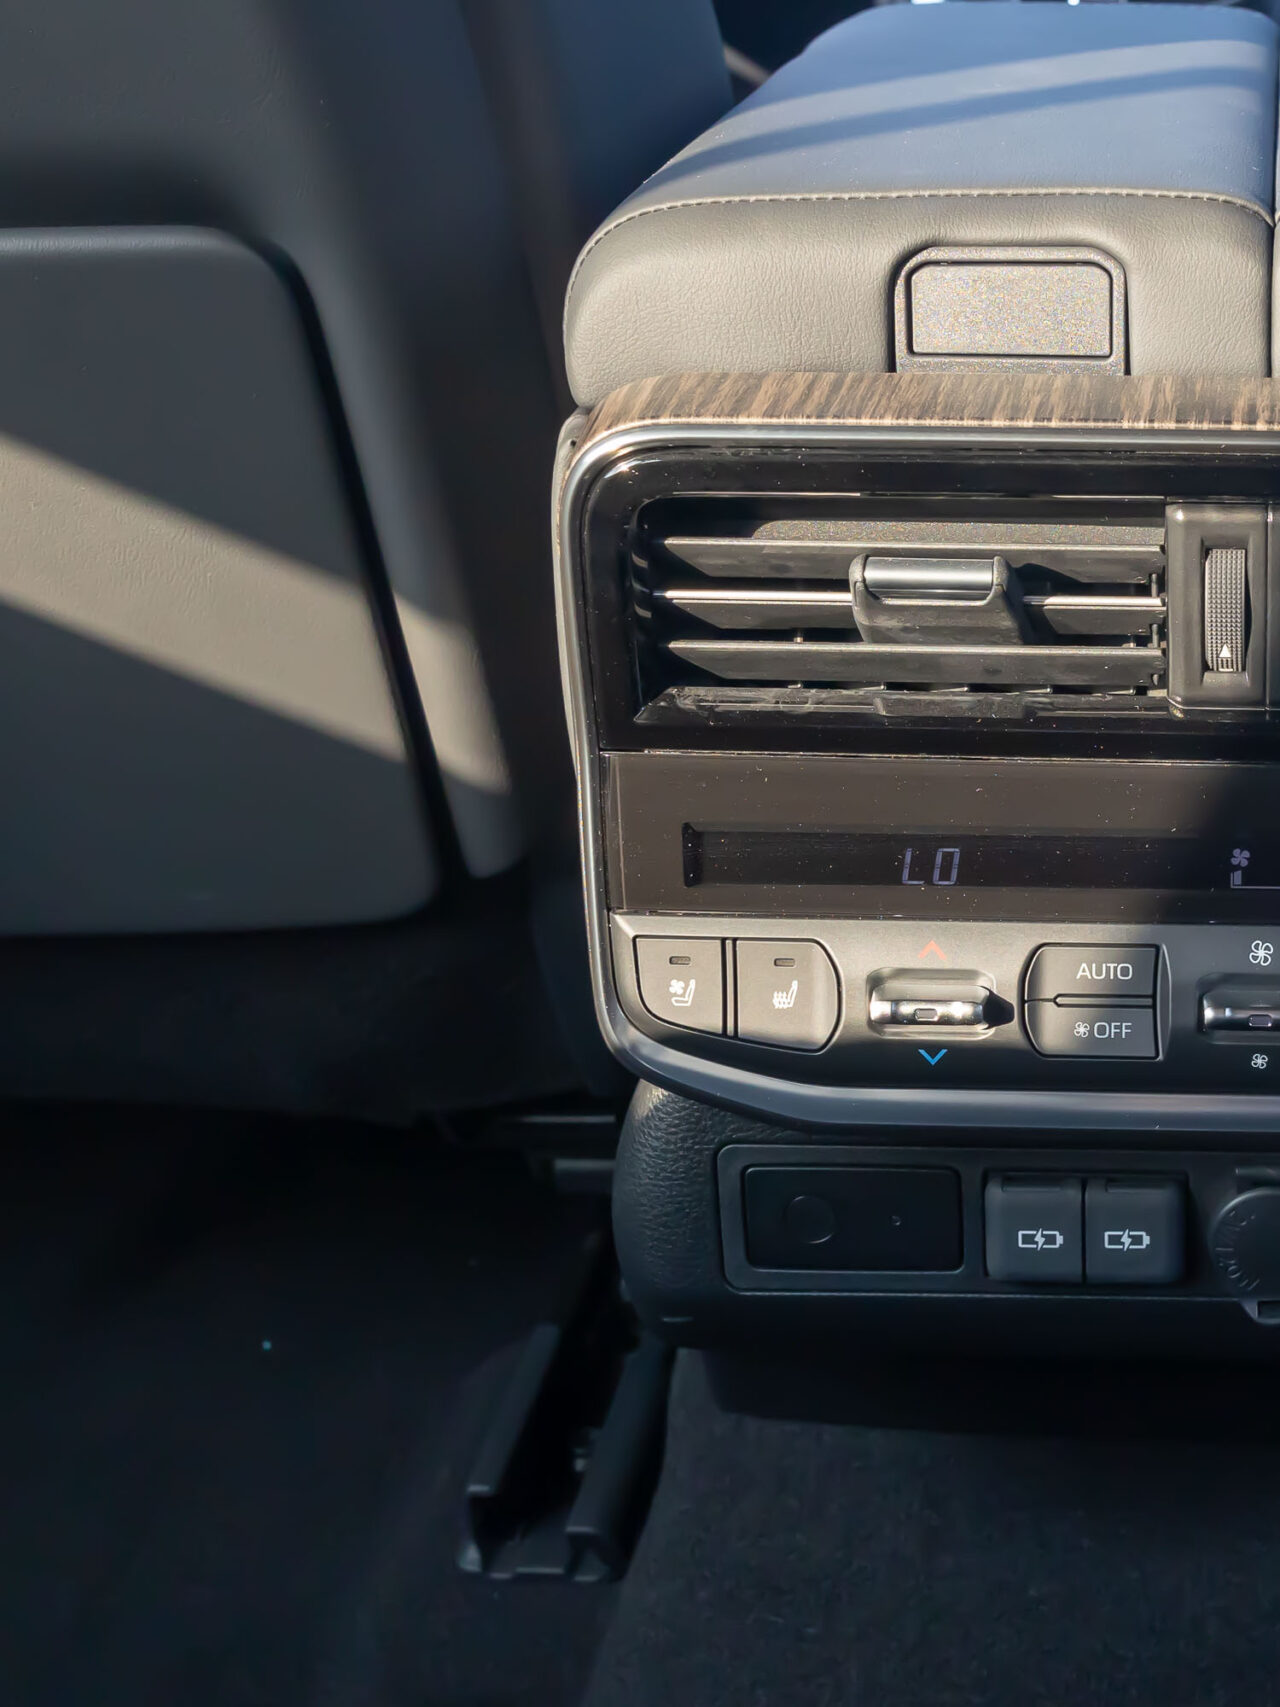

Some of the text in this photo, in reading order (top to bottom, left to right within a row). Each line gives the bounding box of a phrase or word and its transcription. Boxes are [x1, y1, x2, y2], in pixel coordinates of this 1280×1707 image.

[902, 848, 960, 885] LO
[1076, 962, 1133, 980] AUTO
[1093, 1022, 1132, 1039] OFF
